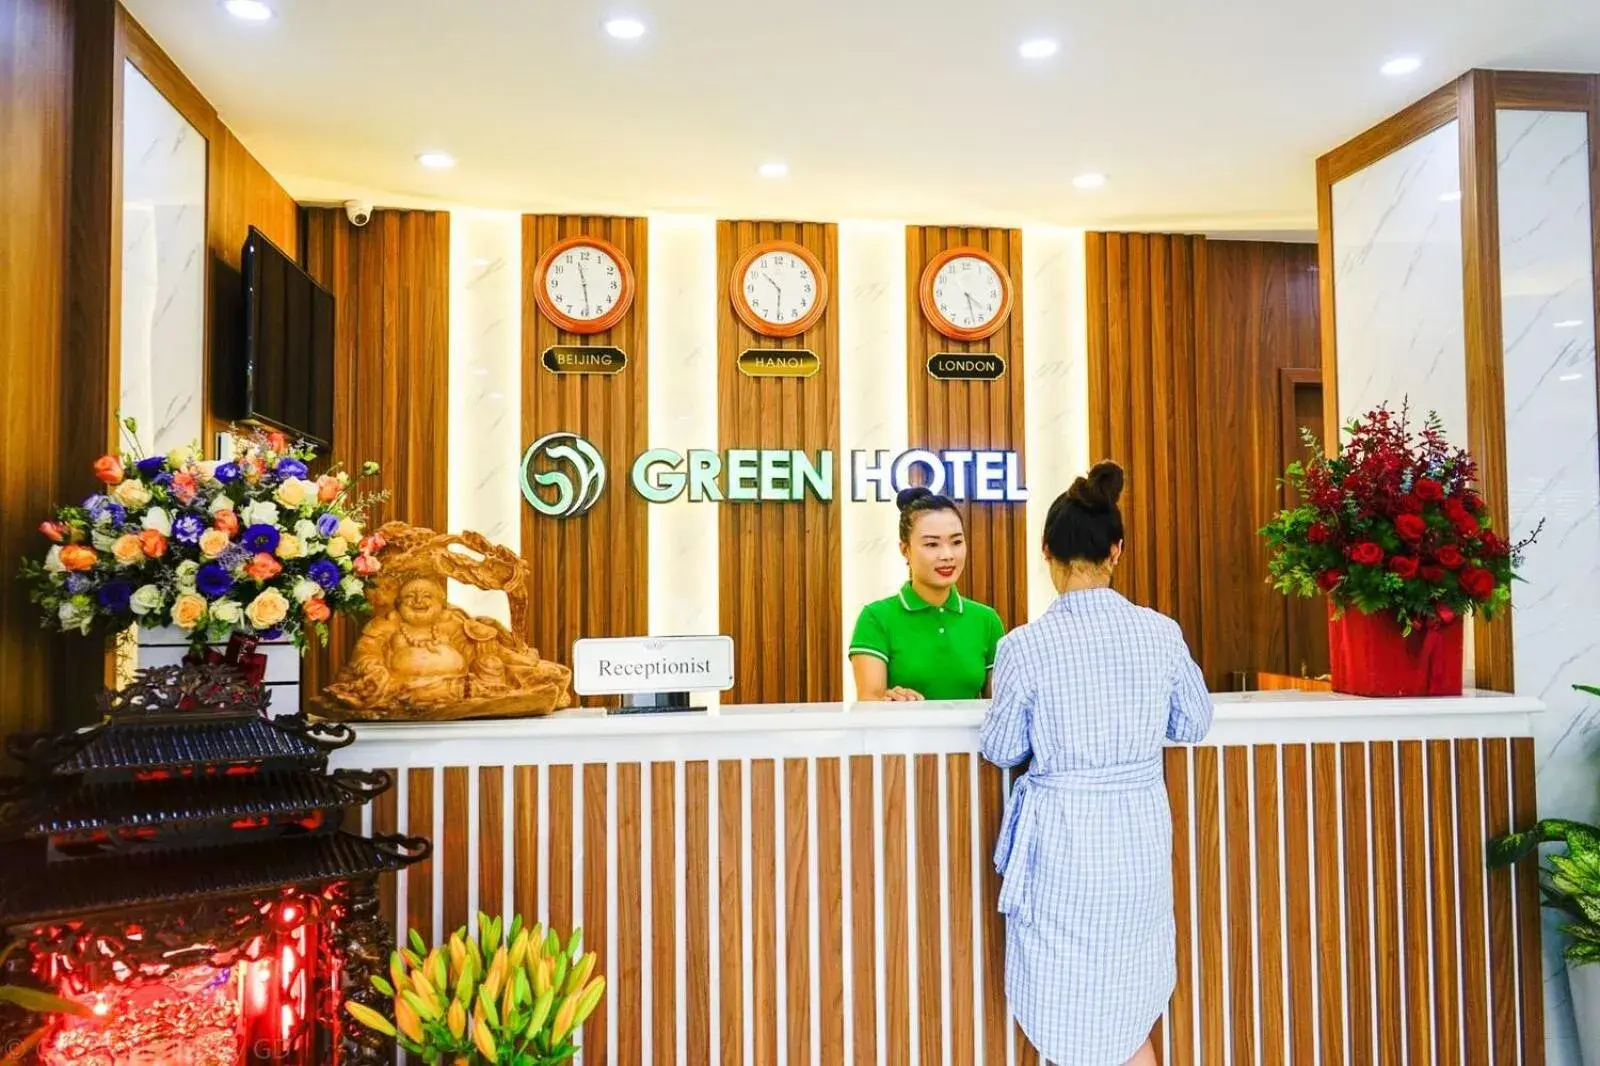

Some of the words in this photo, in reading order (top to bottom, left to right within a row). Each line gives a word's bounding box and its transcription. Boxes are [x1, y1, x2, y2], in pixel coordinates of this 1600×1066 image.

[565, 254, 573, 264] 11
[580, 252, 590, 261] 12
[597, 256, 602, 264] 1
[774, 256, 784, 265] 12
[606, 266, 614, 275] 2
[800, 270, 808, 279] 2
[551, 279, 559, 289] 9
[610, 281, 618, 290] 3
[747, 284, 754, 293] 9
[804, 284, 811, 293] 3
[555, 295, 563, 303] 8
[606, 295, 612, 304] 4
[752, 298, 759, 307] 8
[566, 304, 574, 314] 7
[595, 305, 603, 314] 5
[762, 308, 769, 318] 7
[791, 308, 798, 318] 5
[776, 312, 784, 321] 6
[557, 353, 613, 366] BEIJING
[755, 357, 806, 368] HANOI
[939, 360, 995, 372] LONDON
[631, 448, 833, 503] GREEN
[851, 448, 1029, 502] HOTEL
[599, 657, 711, 680] Receptionist
